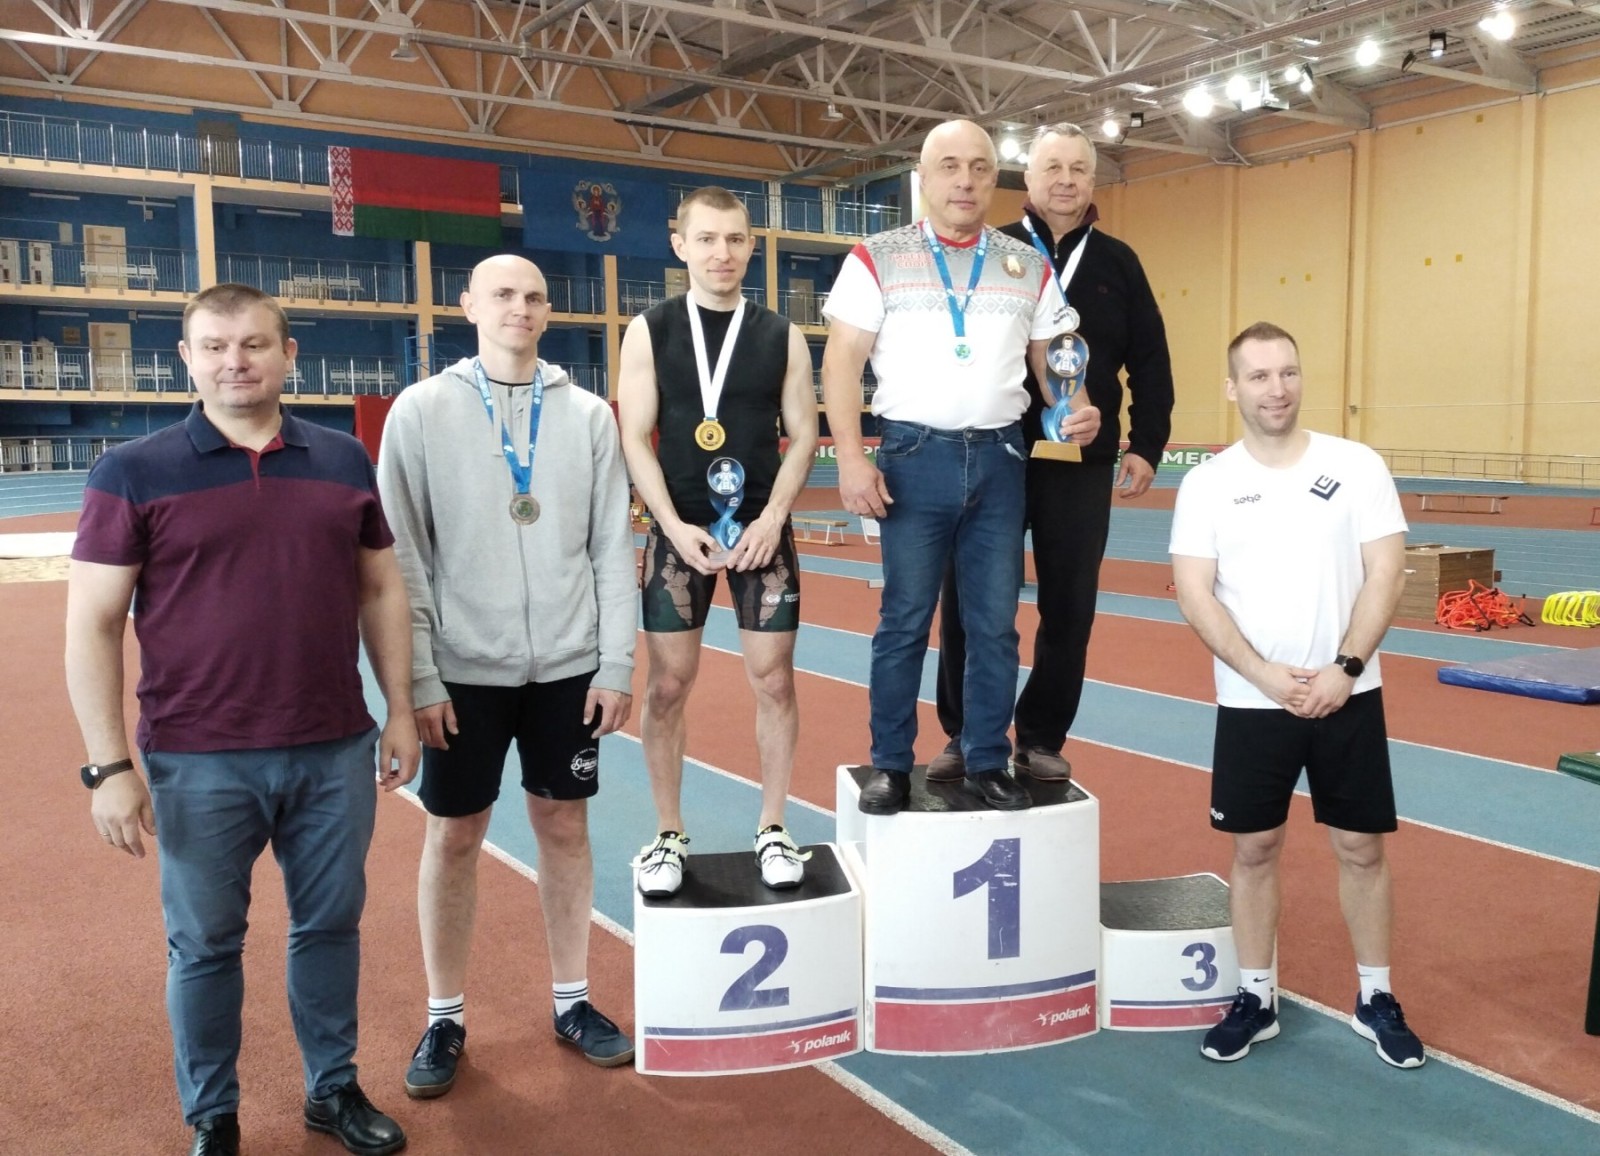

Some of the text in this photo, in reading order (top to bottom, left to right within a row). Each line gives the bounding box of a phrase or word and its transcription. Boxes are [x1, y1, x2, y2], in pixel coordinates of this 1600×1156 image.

[953, 837, 1021, 960] 1
[718, 924, 790, 1012] 2
[1180, 942, 1219, 992] 3
[1050, 1003, 1092, 1027] polanik
[803, 1029, 852, 1054] polanik
